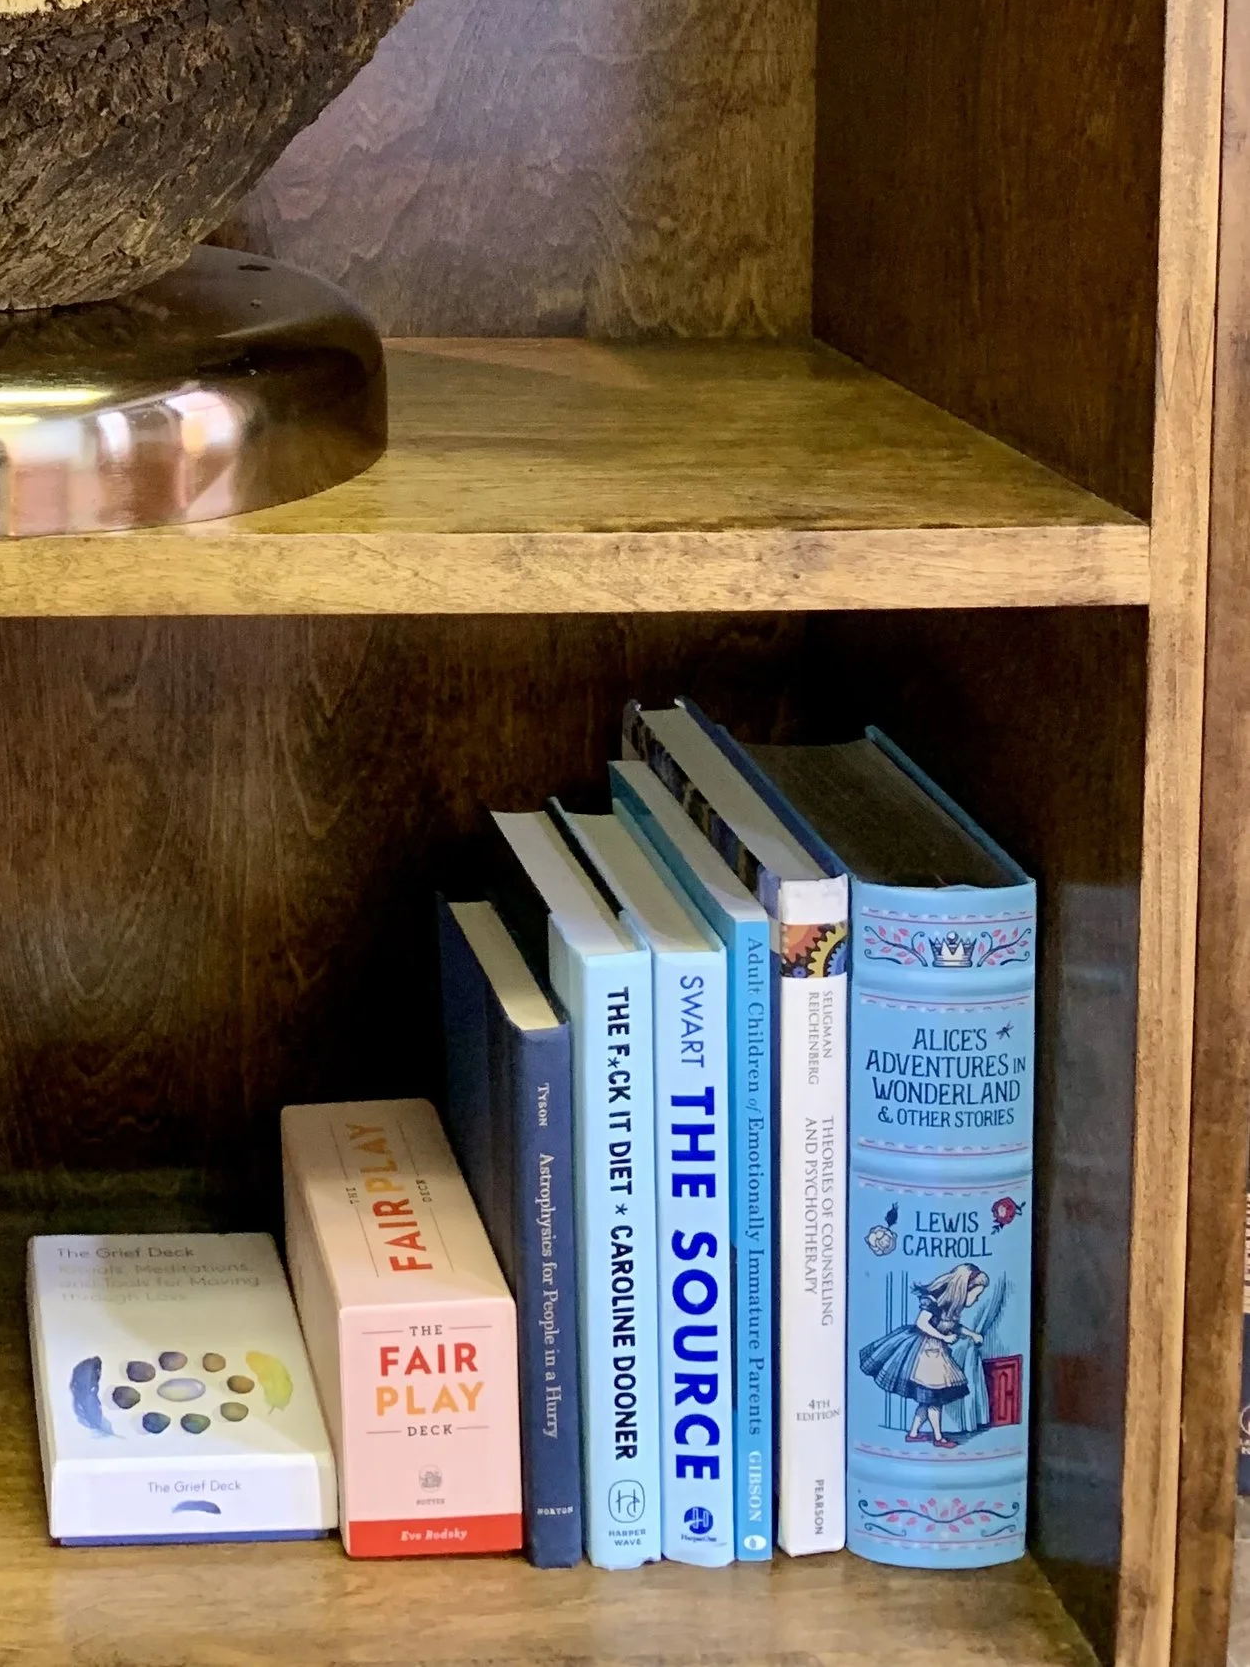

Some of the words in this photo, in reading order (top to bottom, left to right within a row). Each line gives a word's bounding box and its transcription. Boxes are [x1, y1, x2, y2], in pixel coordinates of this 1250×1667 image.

[746, 936, 764, 995] Adult
[607, 987, 630, 1036] THE
[680, 975, 704, 1067] SWART
[822, 990, 833, 1058] SELIGMAN
[746, 1002, 765, 1093] Children
[808, 991, 820, 1085] REICHENBERG
[912, 1028, 987, 1052] ALICE'S
[865, 1049, 1009, 1079] ADVENTURES
[1013, 1056, 1026, 1073] IN
[746, 1098, 763, 1113] of
[872, 1076, 1021, 1105] WONDERLAND
[608, 1111, 631, 1133] IT
[671, 1086, 715, 1198] THE
[804, 1117, 817, 1154] AND
[877, 1106, 894, 1124] &
[897, 1108, 950, 1127] OTHER
[954, 1107, 1015, 1127] STORIES
[345, 1122, 406, 1194] PLAY
[609, 1141, 632, 1195] DIET
[744, 1117, 765, 1242] Emotionally
[821, 1116, 834, 1193] THEORIES
[536, 1153, 558, 1258] Astrophysics
[804, 1160, 818, 1295] PSYCHOTHERAPY
[821, 1197, 834, 1219] OF
[916, 1211, 979, 1233] LEWIS
[58, 1248, 90, 1258] The
[96, 1247, 141, 1259] Grief
[149, 1247, 194, 1258] Deck
[372, 1198, 433, 1272] FAIR
[903, 1235, 993, 1258] CARROLL
[540, 1261, 557, 1285] for
[611, 1226, 635, 1347] CAROLINE
[745, 1248, 765, 1348] Immature
[821, 1223, 834, 1327] COUNSELING
[409, 1325, 443, 1337] THE
[539, 1289, 560, 1345] People
[380, 1343, 478, 1377] FAIR
[543, 1348, 560, 1367] in
[545, 1370, 556, 1382] a
[672, 1230, 721, 1480] SOURCE
[376, 1382, 484, 1416] PLAY
[542, 1384, 563, 1439] Hurry
[613, 1357, 637, 1460] DOONER
[746, 1357, 765, 1435] Parents
[796, 1409, 839, 1421] EDITION
[407, 1424, 453, 1437] DECK
[147, 1482, 171, 1493] The
[174, 1481, 205, 1493] Grief
[210, 1480, 242, 1492] Deck
[748, 1451, 762, 1522] GIBSON
[814, 1479, 824, 1535] PEARSON
[609, 1528, 646, 1537] HARPER
[614, 1538, 642, 1546] WAVE
